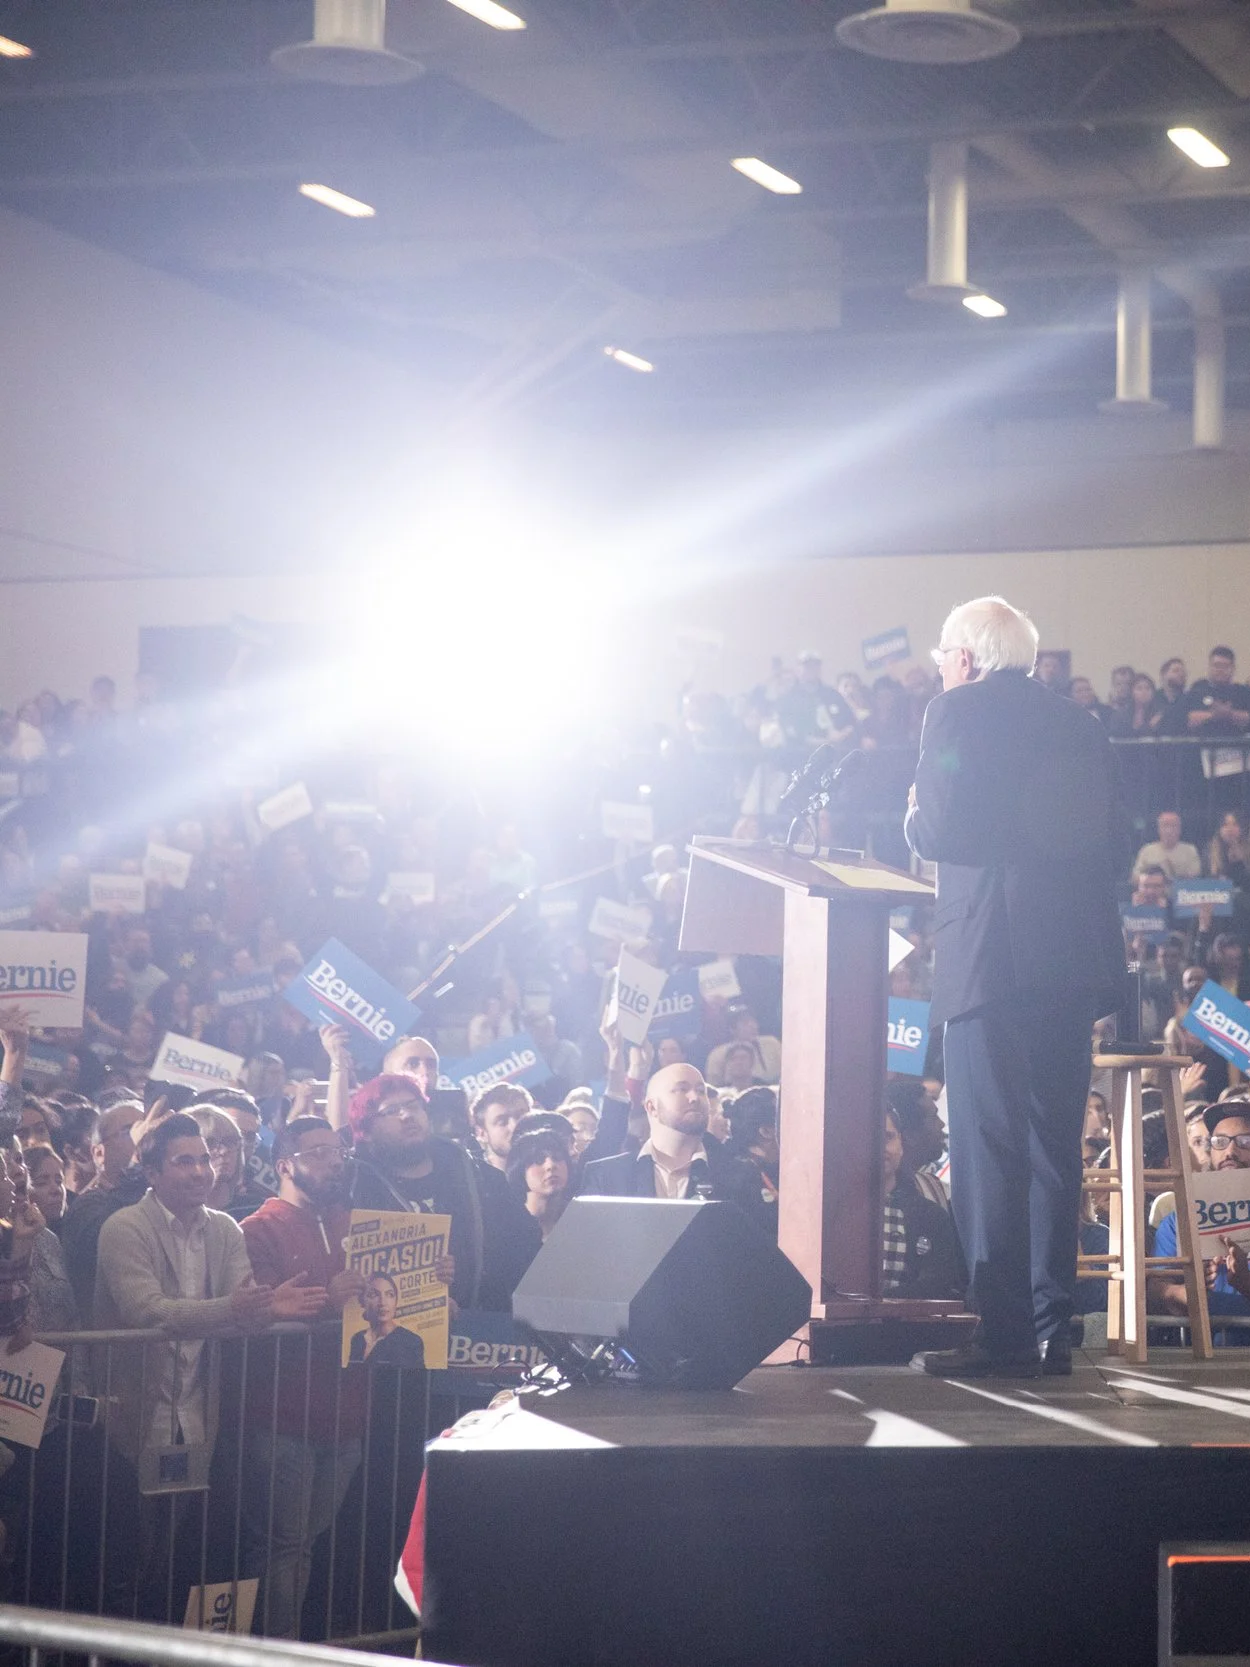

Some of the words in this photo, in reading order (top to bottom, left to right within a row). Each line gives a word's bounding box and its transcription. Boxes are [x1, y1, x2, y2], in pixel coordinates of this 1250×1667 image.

[309, 960, 396, 1041] Bernie
[618, 982, 650, 1014] nie
[656, 990, 694, 1015] nie
[165, 1047, 232, 1081] Bernie
[461, 1049, 534, 1095] Bernie
[352, 1223, 427, 1250] ALEXANDRIA
[400, 1271, 436, 1289] CORTE
